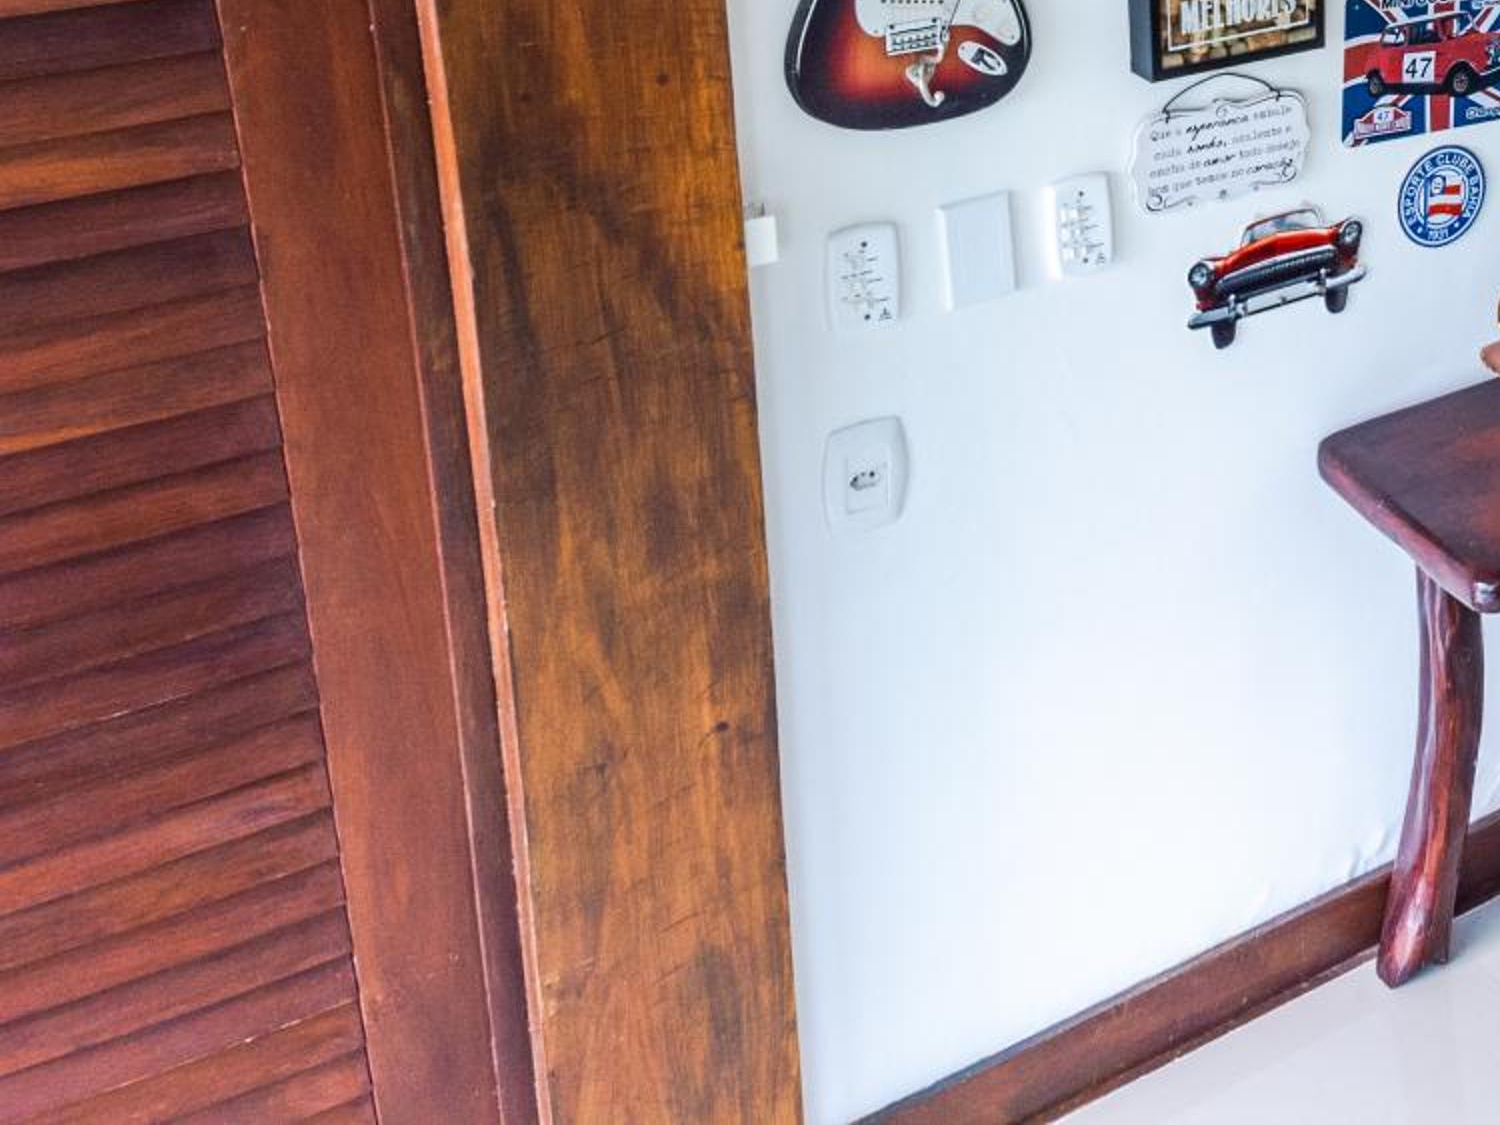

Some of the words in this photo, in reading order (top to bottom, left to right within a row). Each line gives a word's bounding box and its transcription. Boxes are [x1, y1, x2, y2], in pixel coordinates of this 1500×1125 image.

[1404, 56, 1432, 79] 47
[1404, 160, 1434, 226] ESPORTE
[1435, 154, 1475, 176] CLUBE
[1462, 174, 1479, 218] BAHIA
